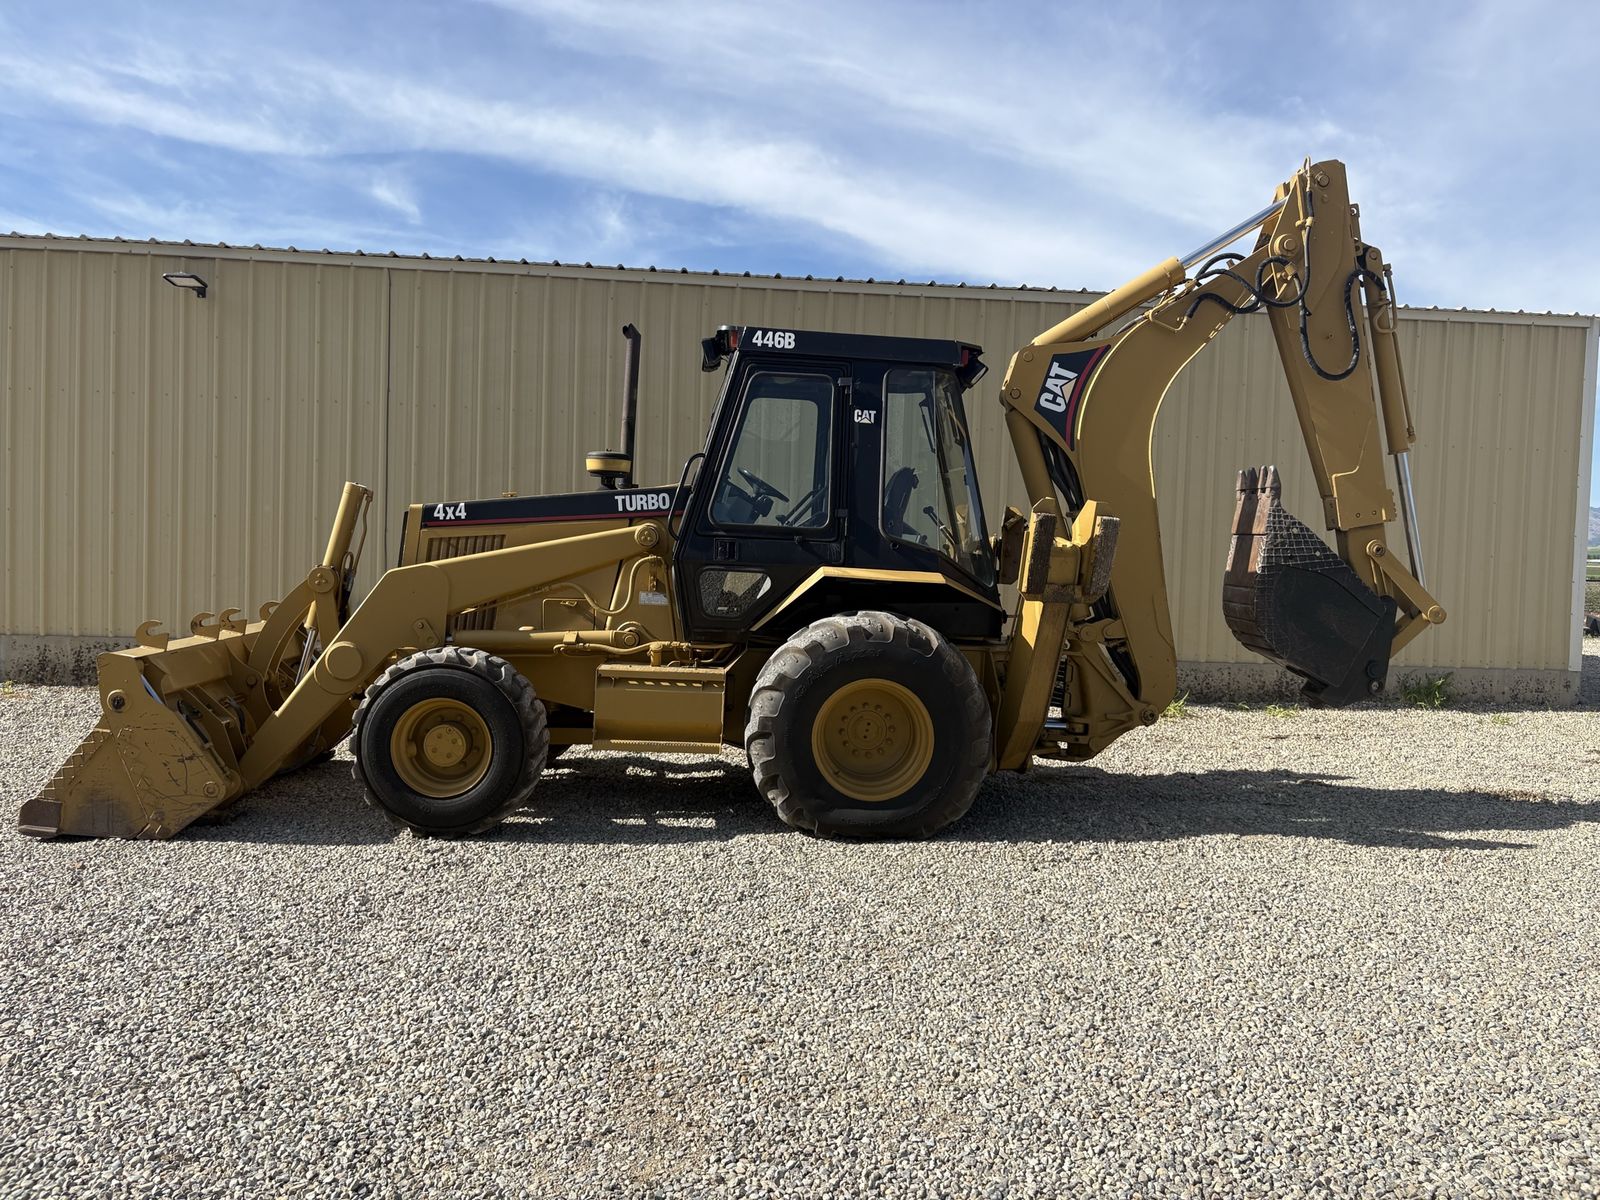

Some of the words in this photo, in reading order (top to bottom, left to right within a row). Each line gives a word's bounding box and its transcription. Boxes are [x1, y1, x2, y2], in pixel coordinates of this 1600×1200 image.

[752, 330, 795, 349] 446B
[1039, 361, 1078, 413] CAT
[854, 409, 877, 424] CAT
[433, 502, 467, 520] 4x4
[615, 492, 670, 512] TURBO
